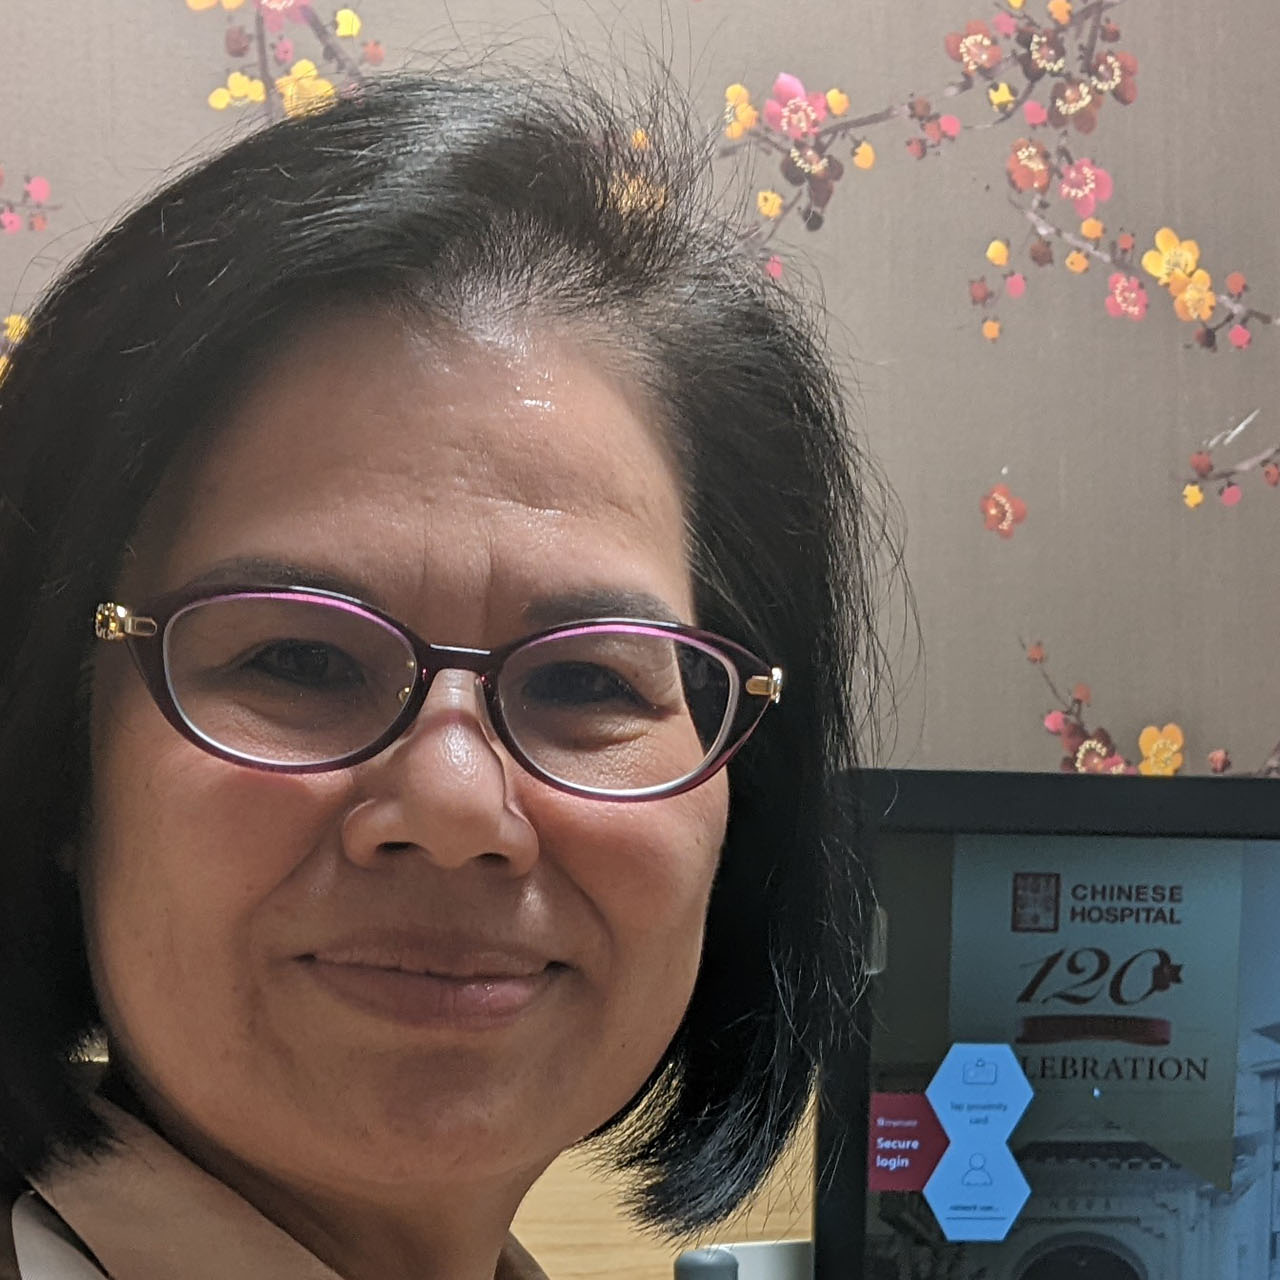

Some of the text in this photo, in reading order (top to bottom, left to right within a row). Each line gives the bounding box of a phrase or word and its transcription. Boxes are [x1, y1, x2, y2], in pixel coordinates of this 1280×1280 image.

[1070, 883, 1184, 903] CHINESE
[1069, 906, 1182, 925] HOSPITAL
[1016, 946, 1174, 1006] 120
[1022, 1056, 1209, 1082] LEBRATION
[876, 1137, 920, 1150] Secure
[876, 1154, 910, 1171] login
